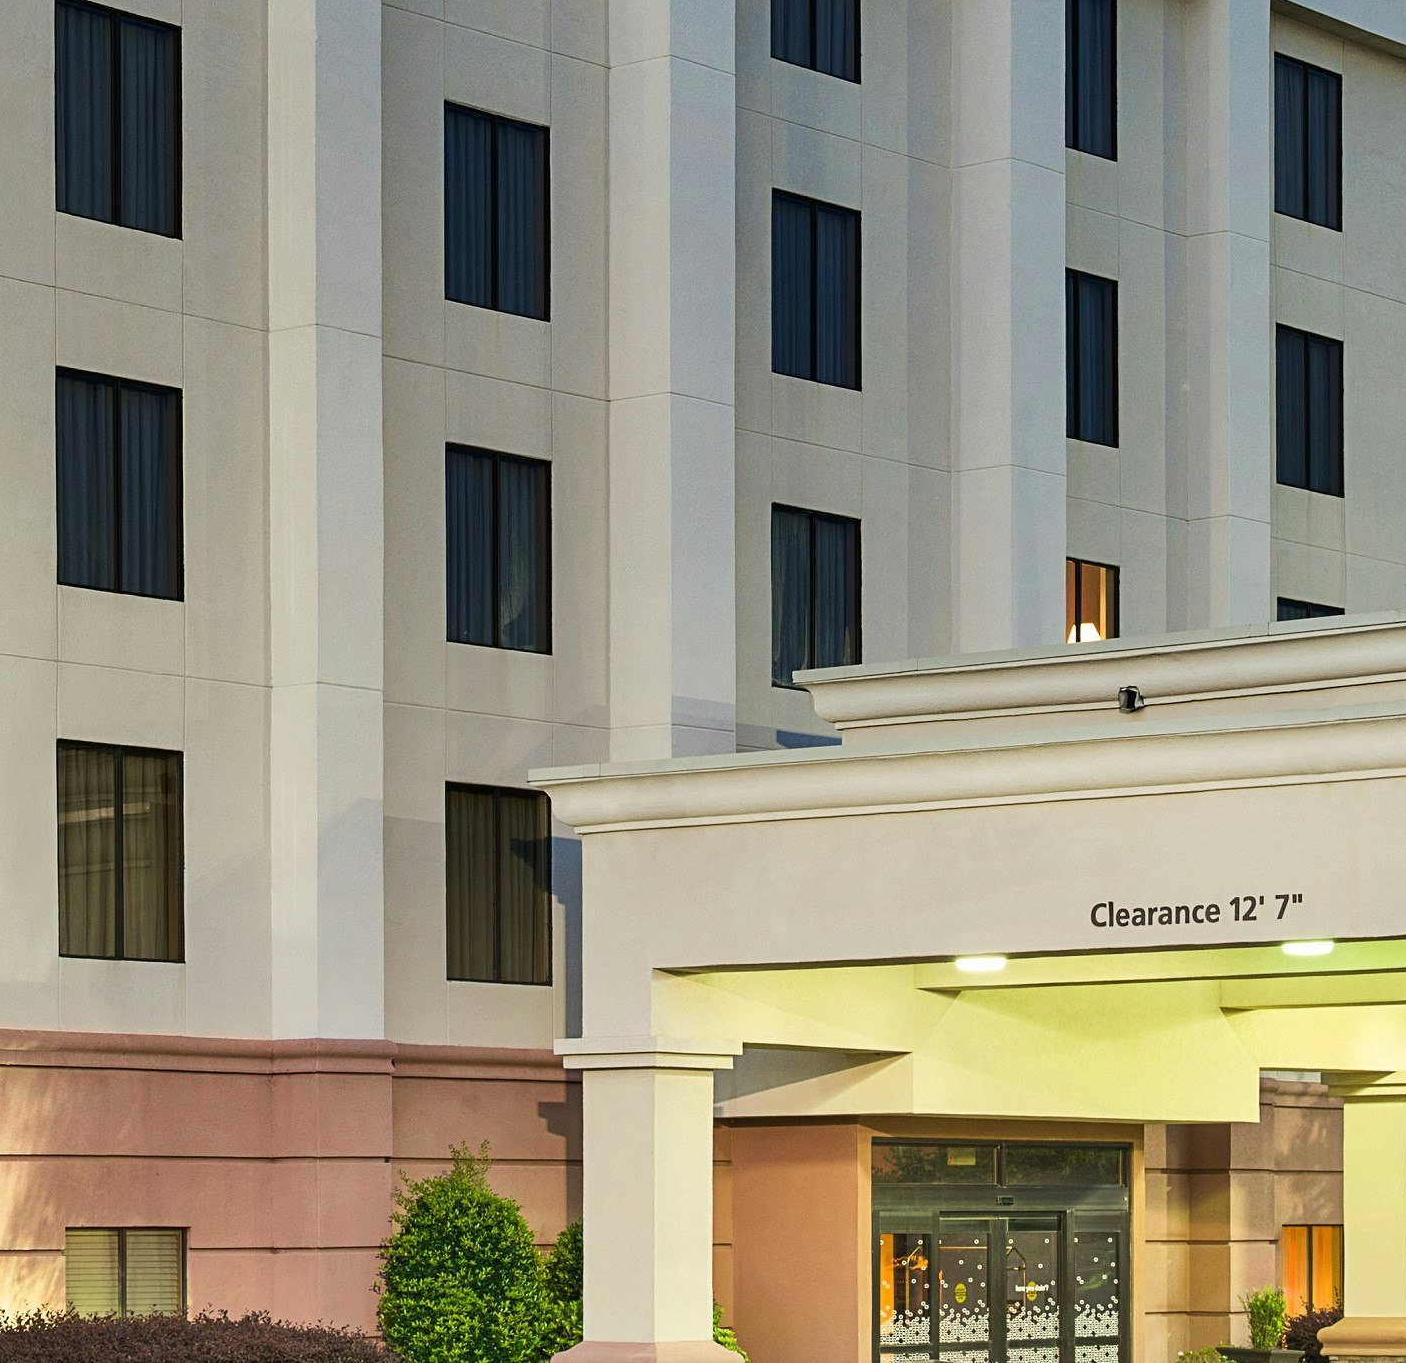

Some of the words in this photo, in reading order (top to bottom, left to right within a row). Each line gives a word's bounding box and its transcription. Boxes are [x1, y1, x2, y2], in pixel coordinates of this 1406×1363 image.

[1090, 901, 1221, 927] Clearance
[1229, 895, 1265, 921] 12'
[1275, 893, 1303, 920] 7"
